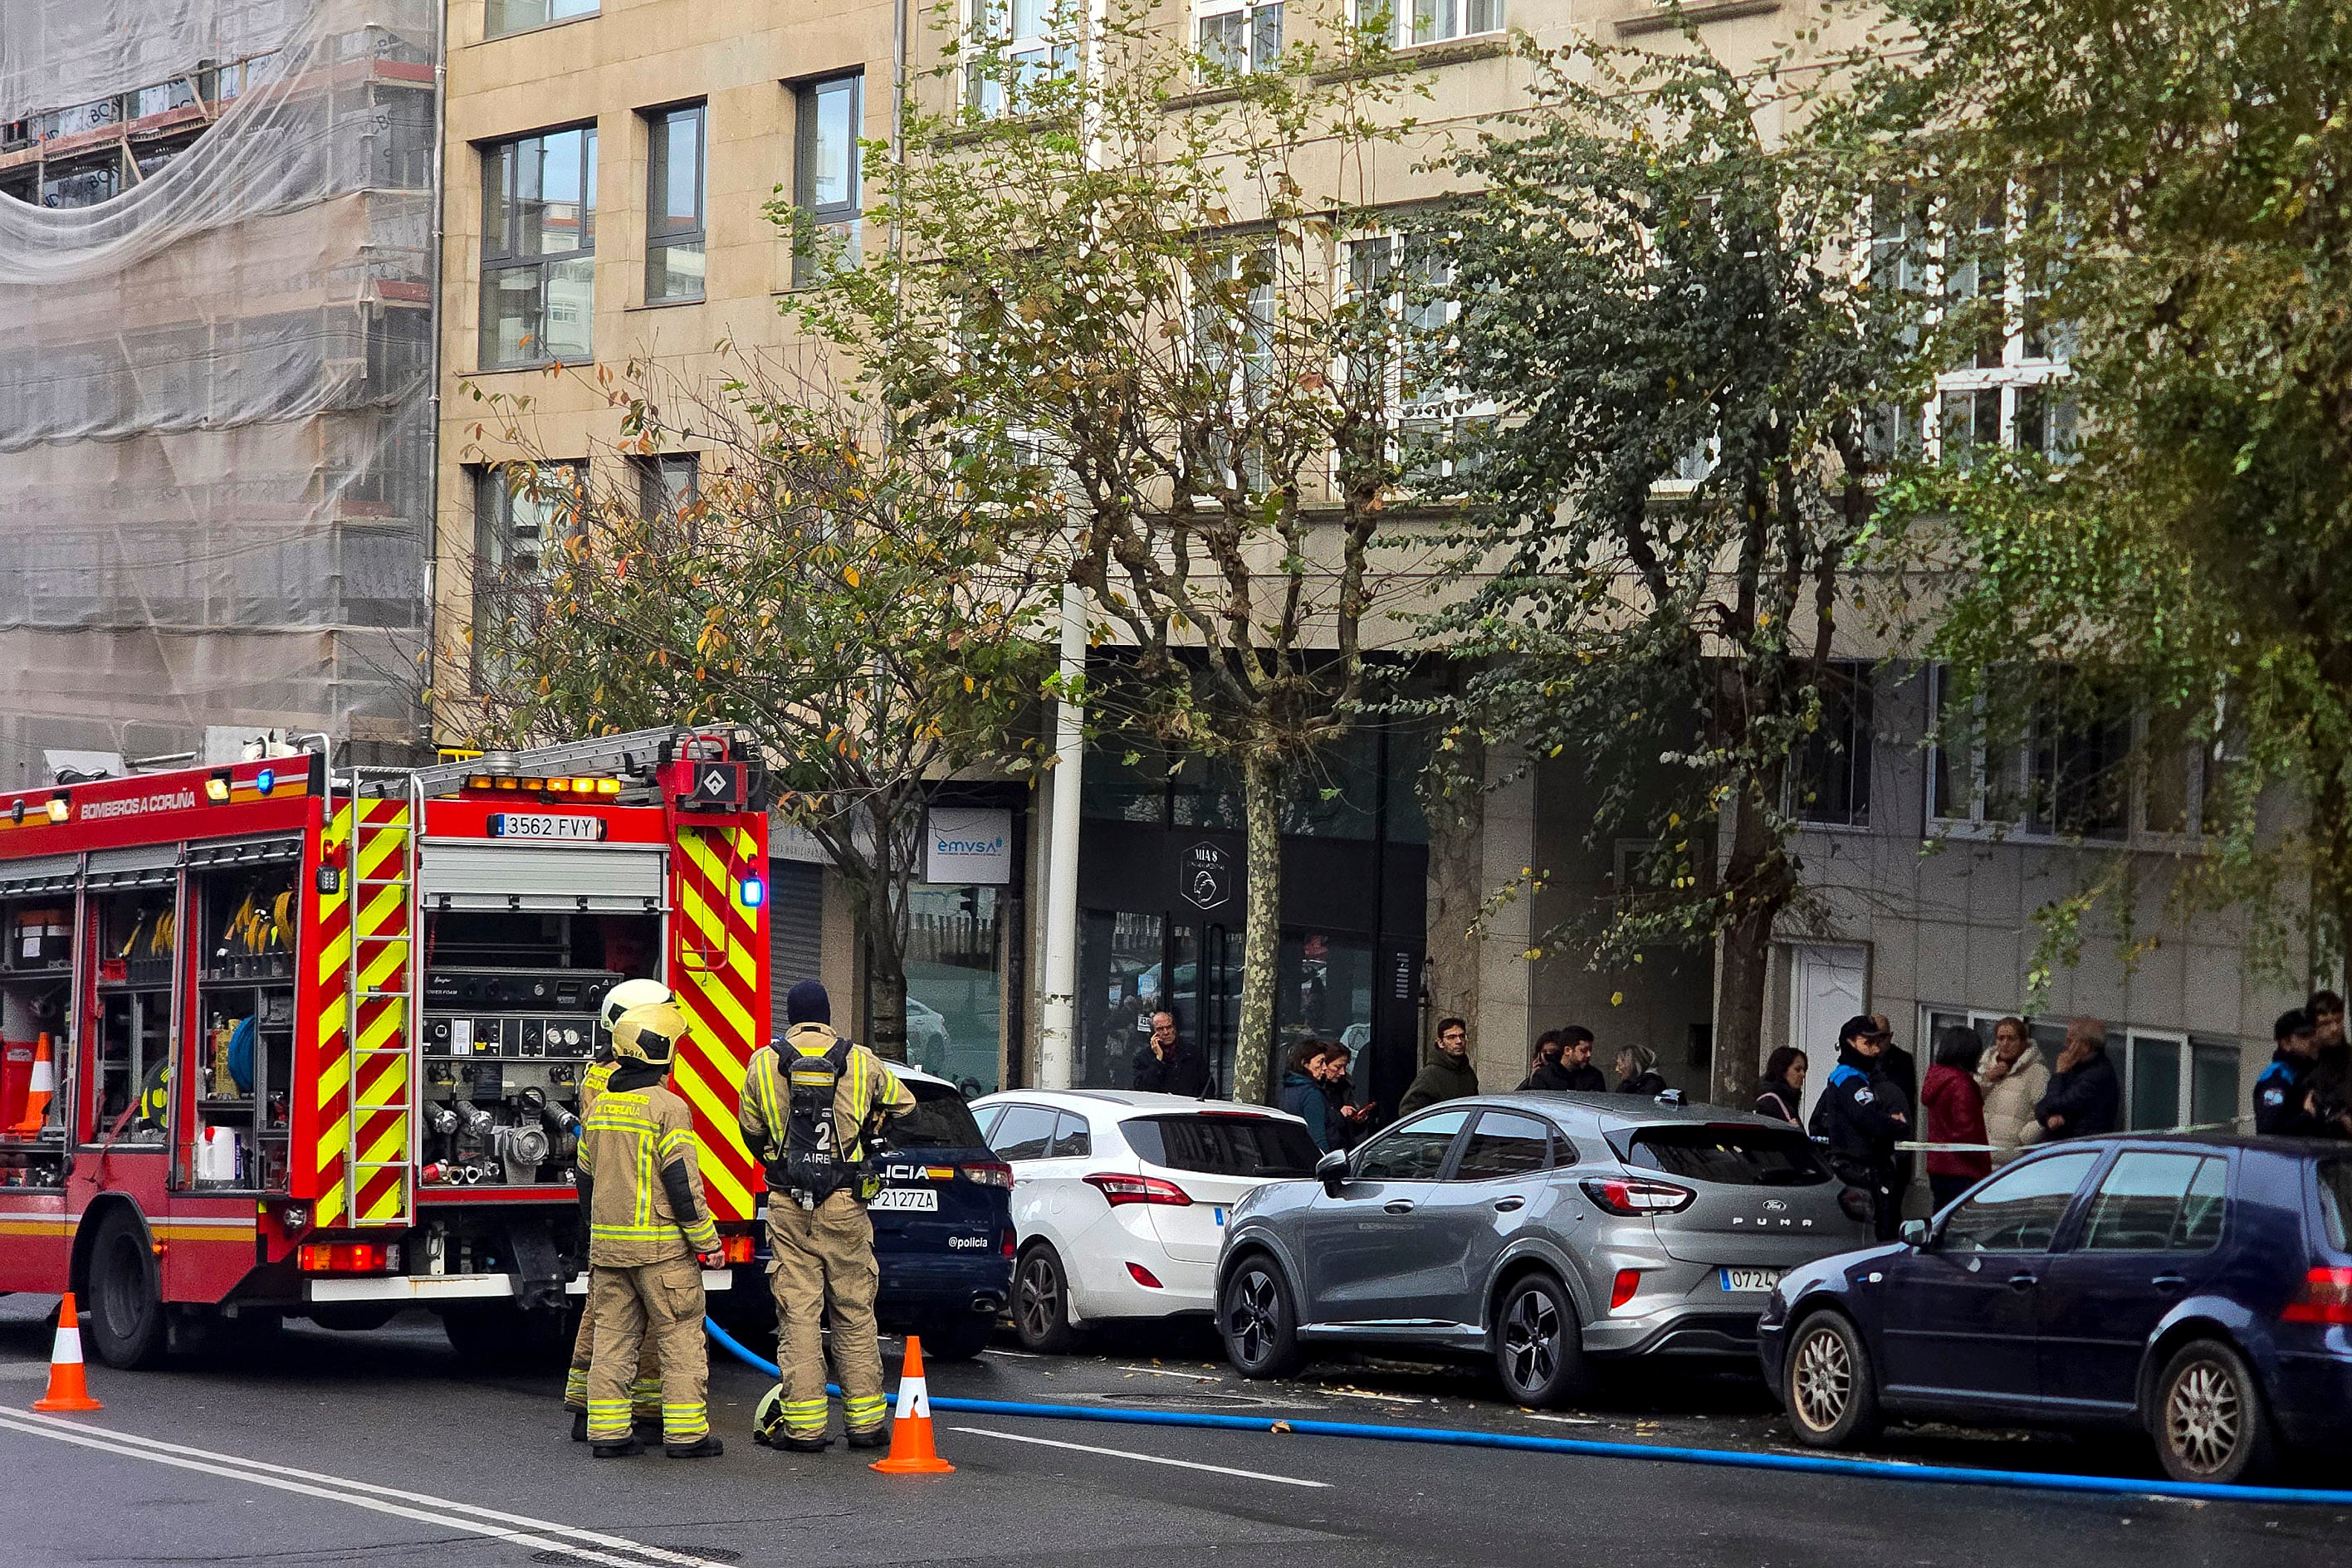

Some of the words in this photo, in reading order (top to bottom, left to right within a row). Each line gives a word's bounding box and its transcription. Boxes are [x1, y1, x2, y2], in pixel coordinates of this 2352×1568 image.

[81, 798, 139, 819] BOMBEROS
[139, 797, 149, 813] A
[149, 787, 196, 812] CORUÑA
[508, 817, 552, 835] 3562
[559, 818, 591, 837] FVY
[814, 1121, 830, 1150] 2
[880, 1165, 930, 1180] ICIA
[869, 1191, 934, 1209] P2127ZA
[1733, 1217, 1812, 1227] PUMA
[948, 1236, 988, 1250] @policia
[1732, 1271, 1774, 1288] 0724
